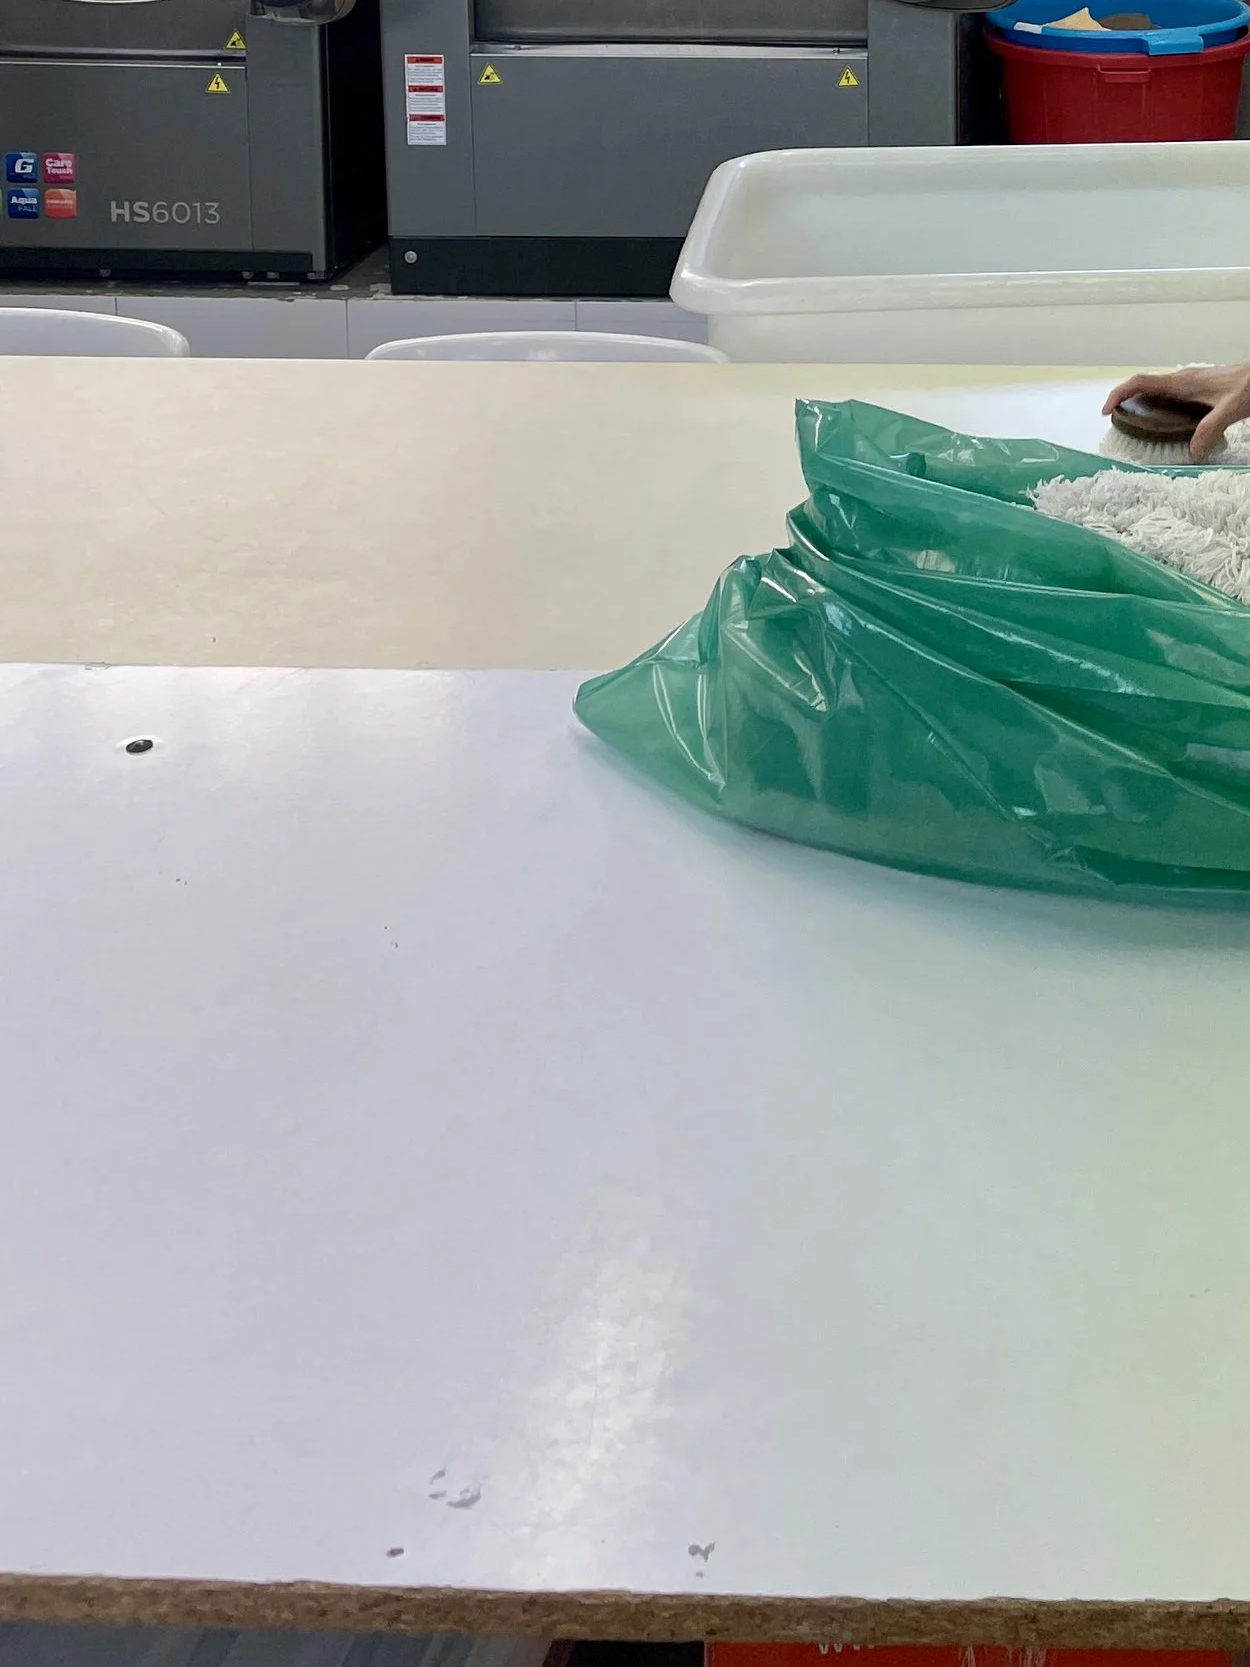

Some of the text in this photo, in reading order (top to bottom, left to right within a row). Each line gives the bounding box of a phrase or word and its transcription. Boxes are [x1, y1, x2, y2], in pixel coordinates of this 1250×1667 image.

[15, 159, 35, 173] G
[45, 158, 74, 168] Care
[11, 196, 38, 205] Aqua
[110, 201, 220, 224] HS6013
